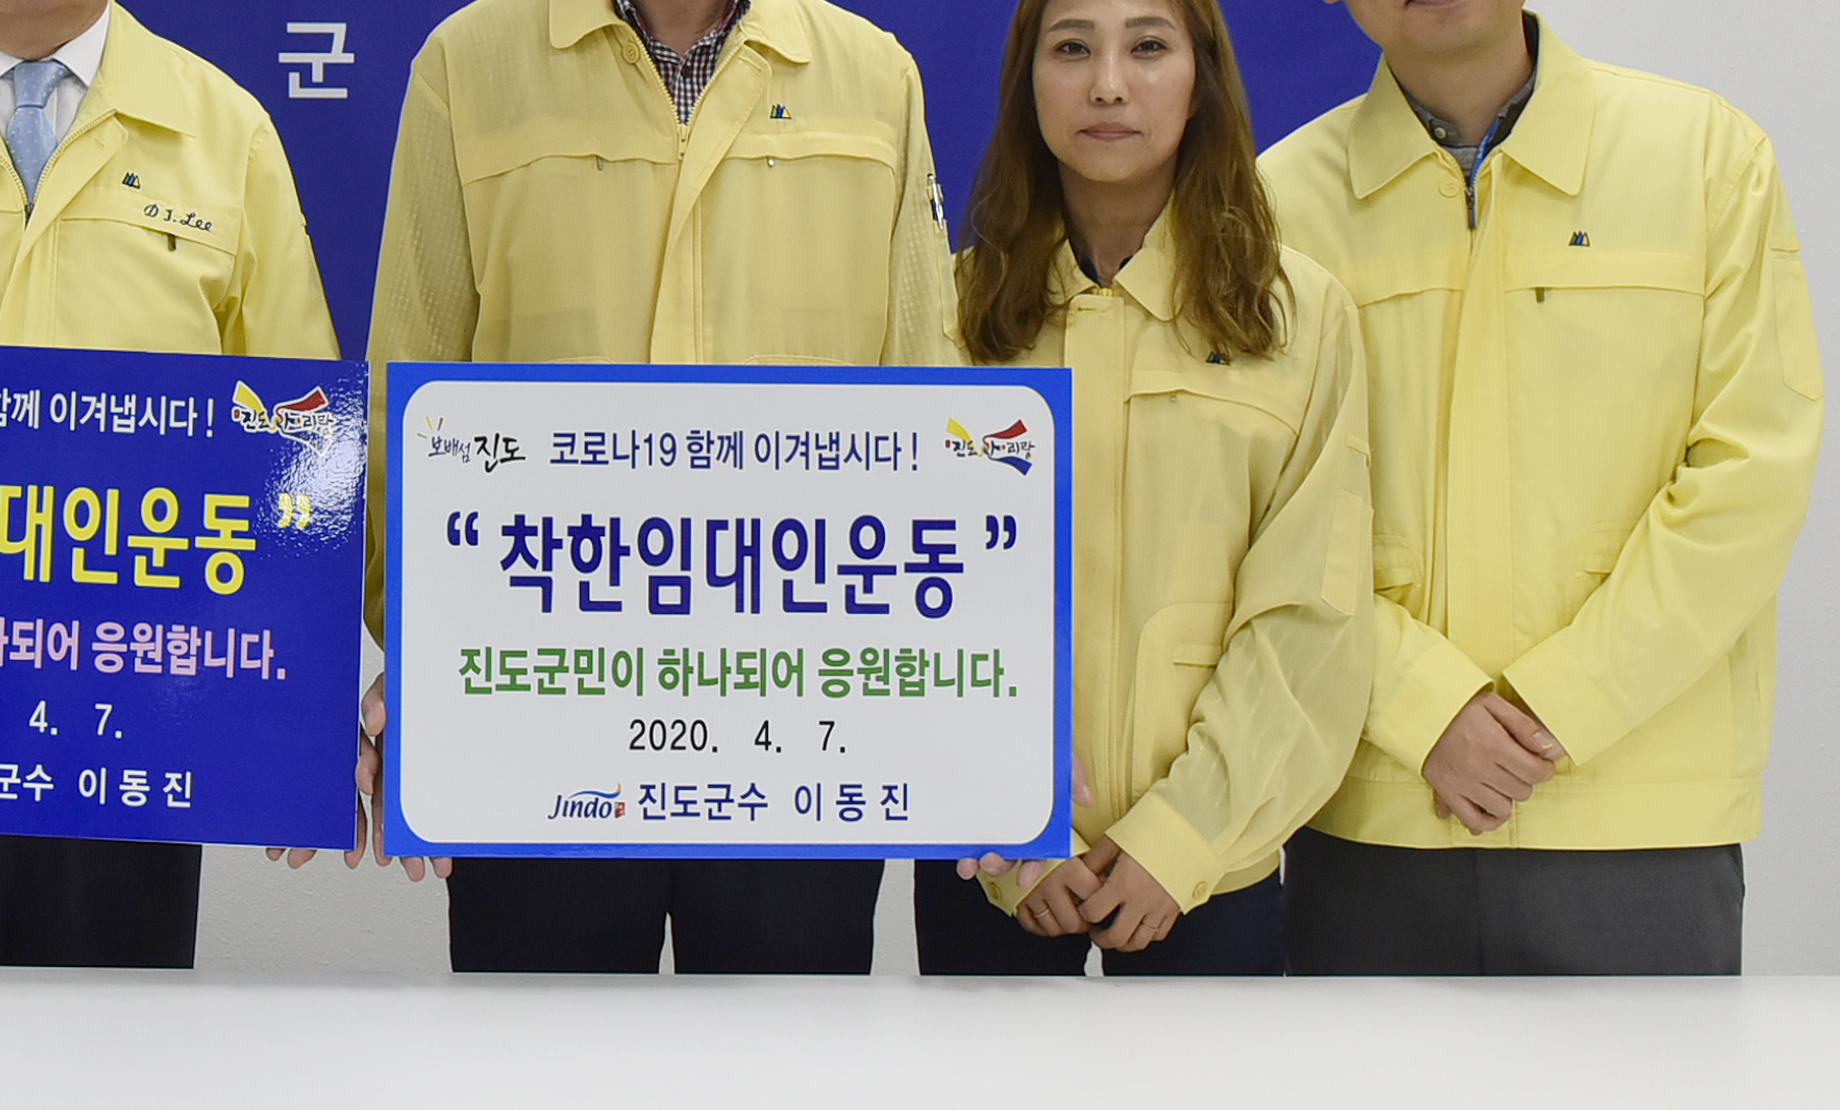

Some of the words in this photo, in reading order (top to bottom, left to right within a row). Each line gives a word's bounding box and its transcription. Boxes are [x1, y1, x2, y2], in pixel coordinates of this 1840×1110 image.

[278, 22, 355, 99] 군
[474, 433, 526, 472] 진도
[550, 430, 678, 469] 코로나19
[685, 430, 744, 471] 함께
[91, 621, 286, 680] 응원합니다.
[459, 646, 643, 697] 진도군민이
[658, 647, 805, 698] 하나되어
[818, 647, 1018, 698] 응원합니다.
[29, 700, 59, 737] 4.
[94, 704, 123, 738] 7.
[629, 719, 720, 753] 2020.
[754, 720, 783, 753] 4.
[818, 720, 847, 753] 7.
[548, 795, 612, 820] Jindo
[638, 782, 769, 822] 진도군수
